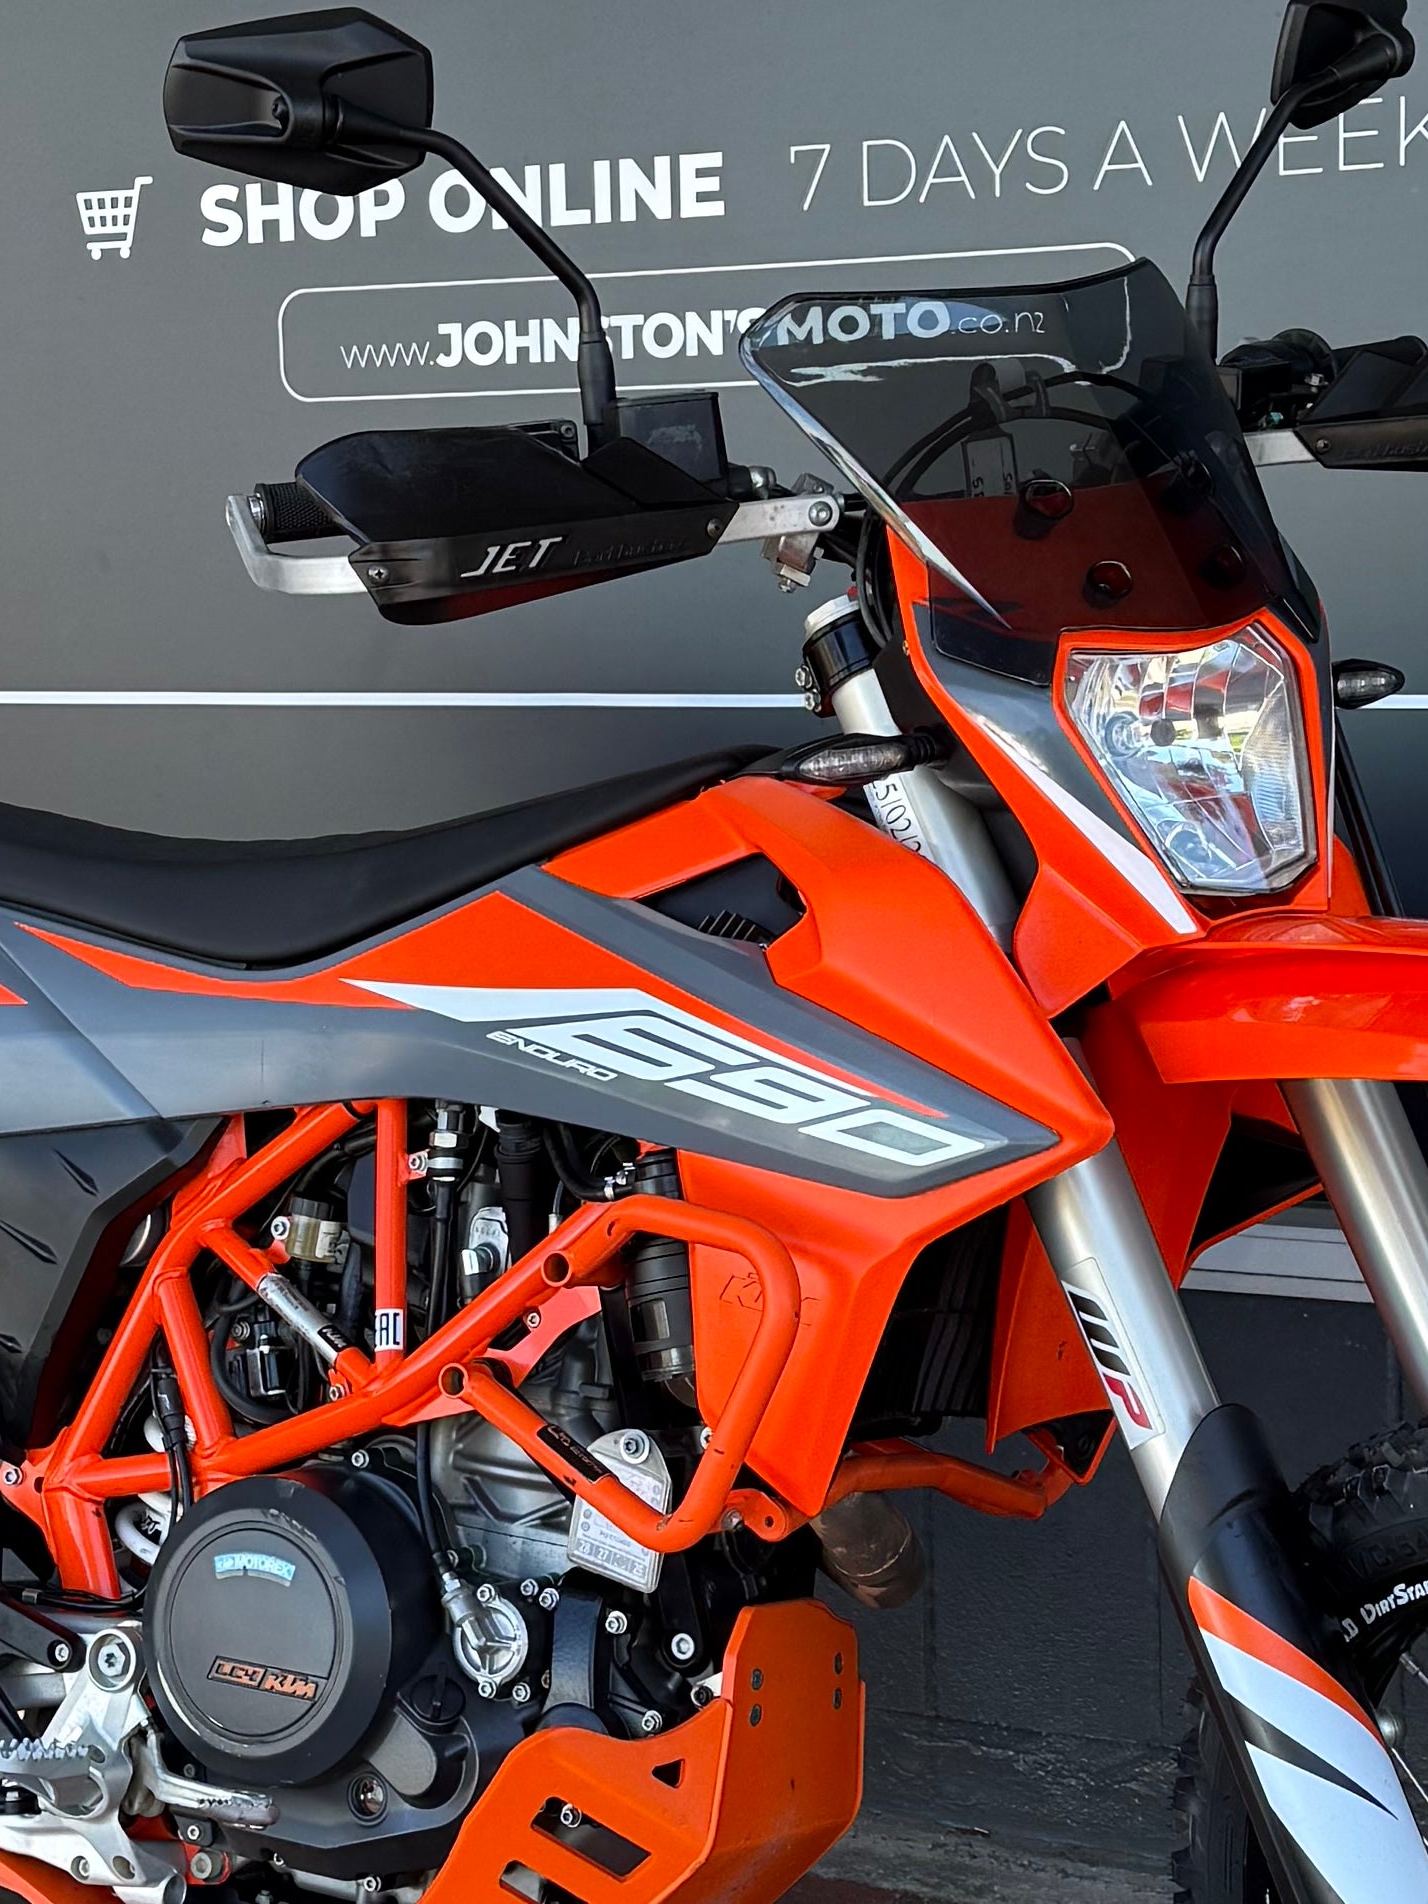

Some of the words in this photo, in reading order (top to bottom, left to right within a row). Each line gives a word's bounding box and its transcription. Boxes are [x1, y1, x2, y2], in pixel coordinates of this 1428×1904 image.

[199, 175, 407, 247] SHOP
[428, 150, 727, 234] ONLINE
[789, 143, 832, 212] 7
[861, 124, 1069, 208] DAYS
[1093, 120, 1153, 191] A
[459, 535, 564, 579] JET
[485, 1029, 620, 1082] ENDURO
[505, 1014, 986, 1167] 690
[375, 1312, 401, 1346] AC
[235, 1552, 294, 1579] MOTOREX
[214, 1662, 260, 1684] LC4
[263, 1673, 316, 1700] KTM
